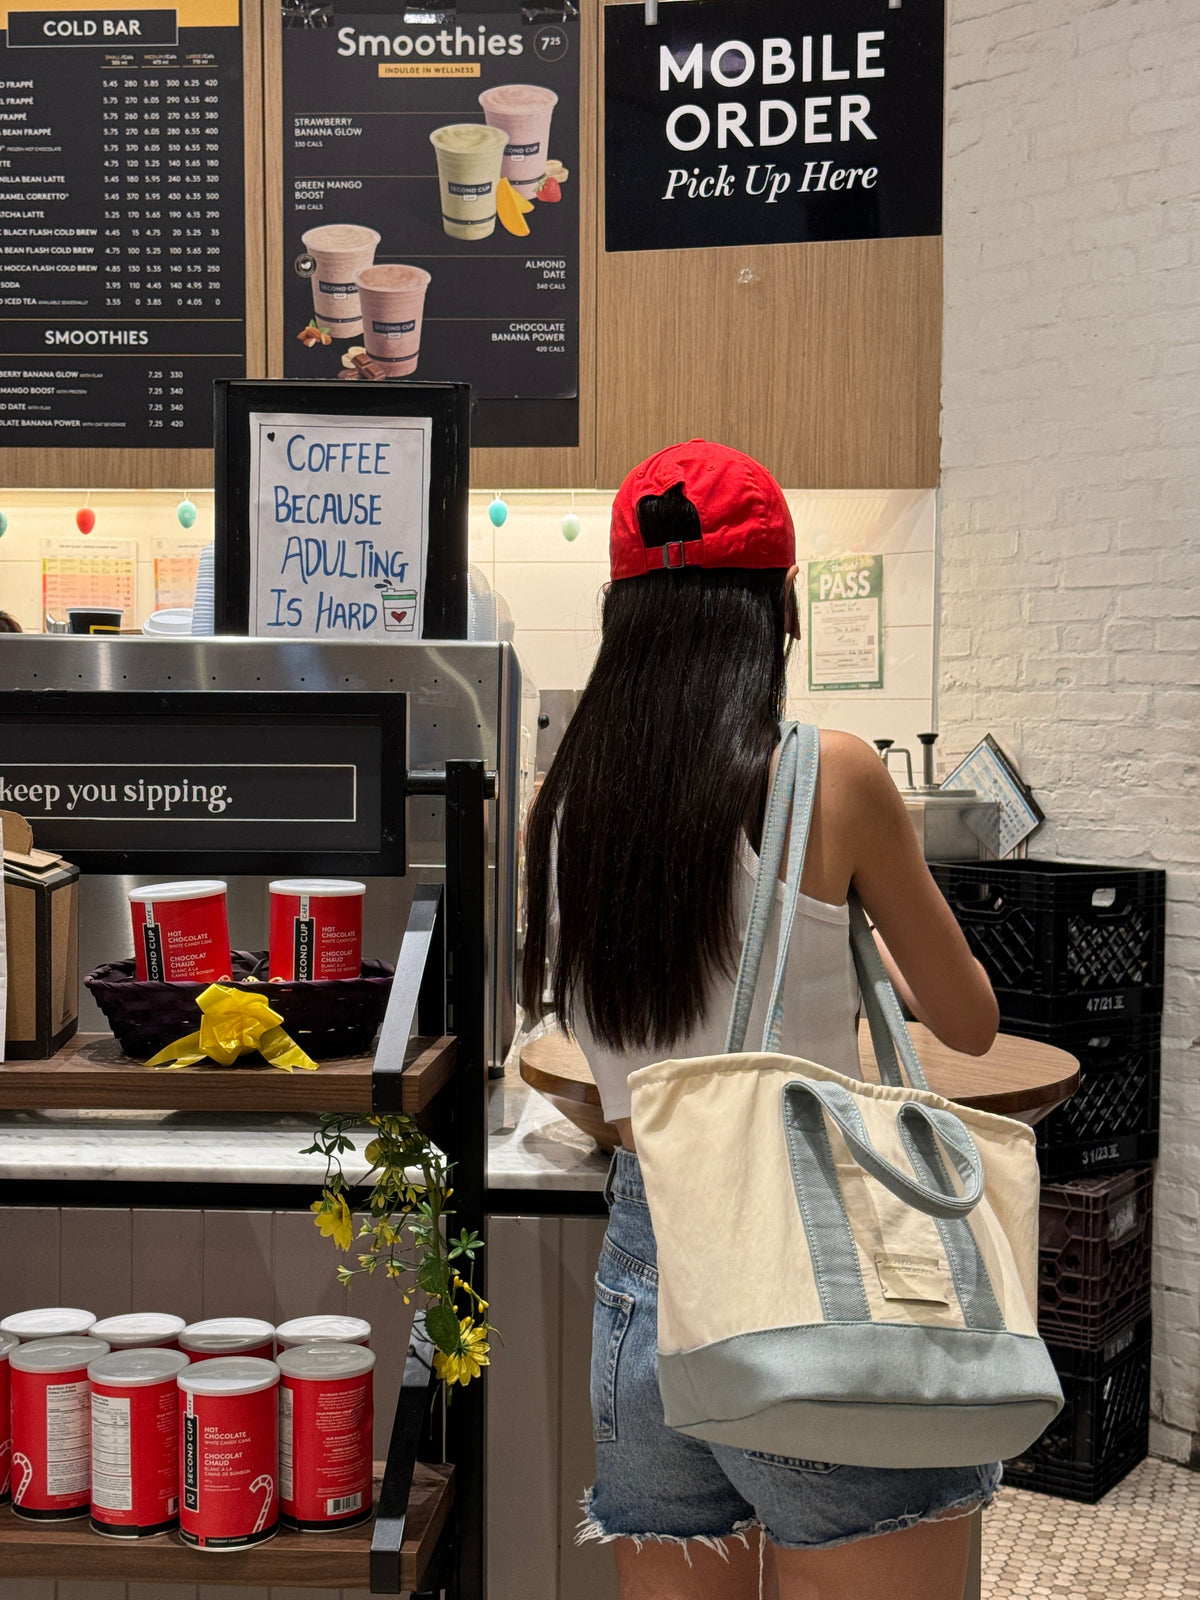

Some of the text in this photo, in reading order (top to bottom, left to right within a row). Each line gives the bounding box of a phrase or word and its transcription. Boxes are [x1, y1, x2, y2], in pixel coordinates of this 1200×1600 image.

[43, 20, 142, 37] COLD BAR
[337, 26, 523, 56] Smoothies
[660, 30, 885, 91] MOBILE
[435, 66, 474, 74] WELLNESS
[6, 80, 34, 88] FRAPPÉ
[125, 79, 137, 87] 280
[144, 79, 159, 87] 5.85
[167, 79, 180, 87] 300
[205, 78, 218, 86] 420
[6, 97, 34, 105] FRAPPÉ
[294, 118, 352, 126] STRAWBERRY
[665, 94, 878, 151] ORDER
[2, 127, 51, 136] BEAN FRAPPÉ
[294, 128, 362, 136] BANANA GLOW
[104, 159, 119, 167] 4.75
[127, 159, 138, 167] 120
[145, 159, 160, 167] 5.25
[186, 159, 200, 167] 5.65
[185, 174, 201, 182] 6.35
[207, 174, 219, 182] 320
[661, 161, 878, 203] Pick Up Here
[295, 181, 362, 190] GREEN MANGO
[295, 191, 324, 199] BOOST
[187, 210, 200, 218] 6.15
[207, 210, 219, 218] 290
[146, 228, 161, 236] 4.75
[173, 228, 181, 236] 20
[187, 228, 201, 236] 5.25
[211, 228, 219, 236] 35
[525, 260, 565, 269] ALMOND
[543, 270, 565, 279] DATE
[106, 281, 121, 289] 3.95
[129, 281, 140, 289] 110
[509, 323, 565, 332] CHOCOLATE
[44, 330, 149, 345] SMOOTHIES
[491, 332, 565, 341] BANANA POWER
[148, 371, 163, 379] 7.25
[286, 434, 390, 474] COFFEE
[273, 485, 381, 526] BECAUSE
[819, 570, 871, 600] PASS
[315, 591, 377, 633] HARD
[0, 776, 233, 813] keep you sipping.
[300, 923, 308, 943] CUP
[148, 930, 156, 949] CUP
[168, 933, 208, 943] CHOCOLATE
[170, 953, 206, 962] CHOCOLAT
[204, 1432, 246, 1440] CHOCOLATE
[204, 1452, 243, 1460] CHOCOLAT
